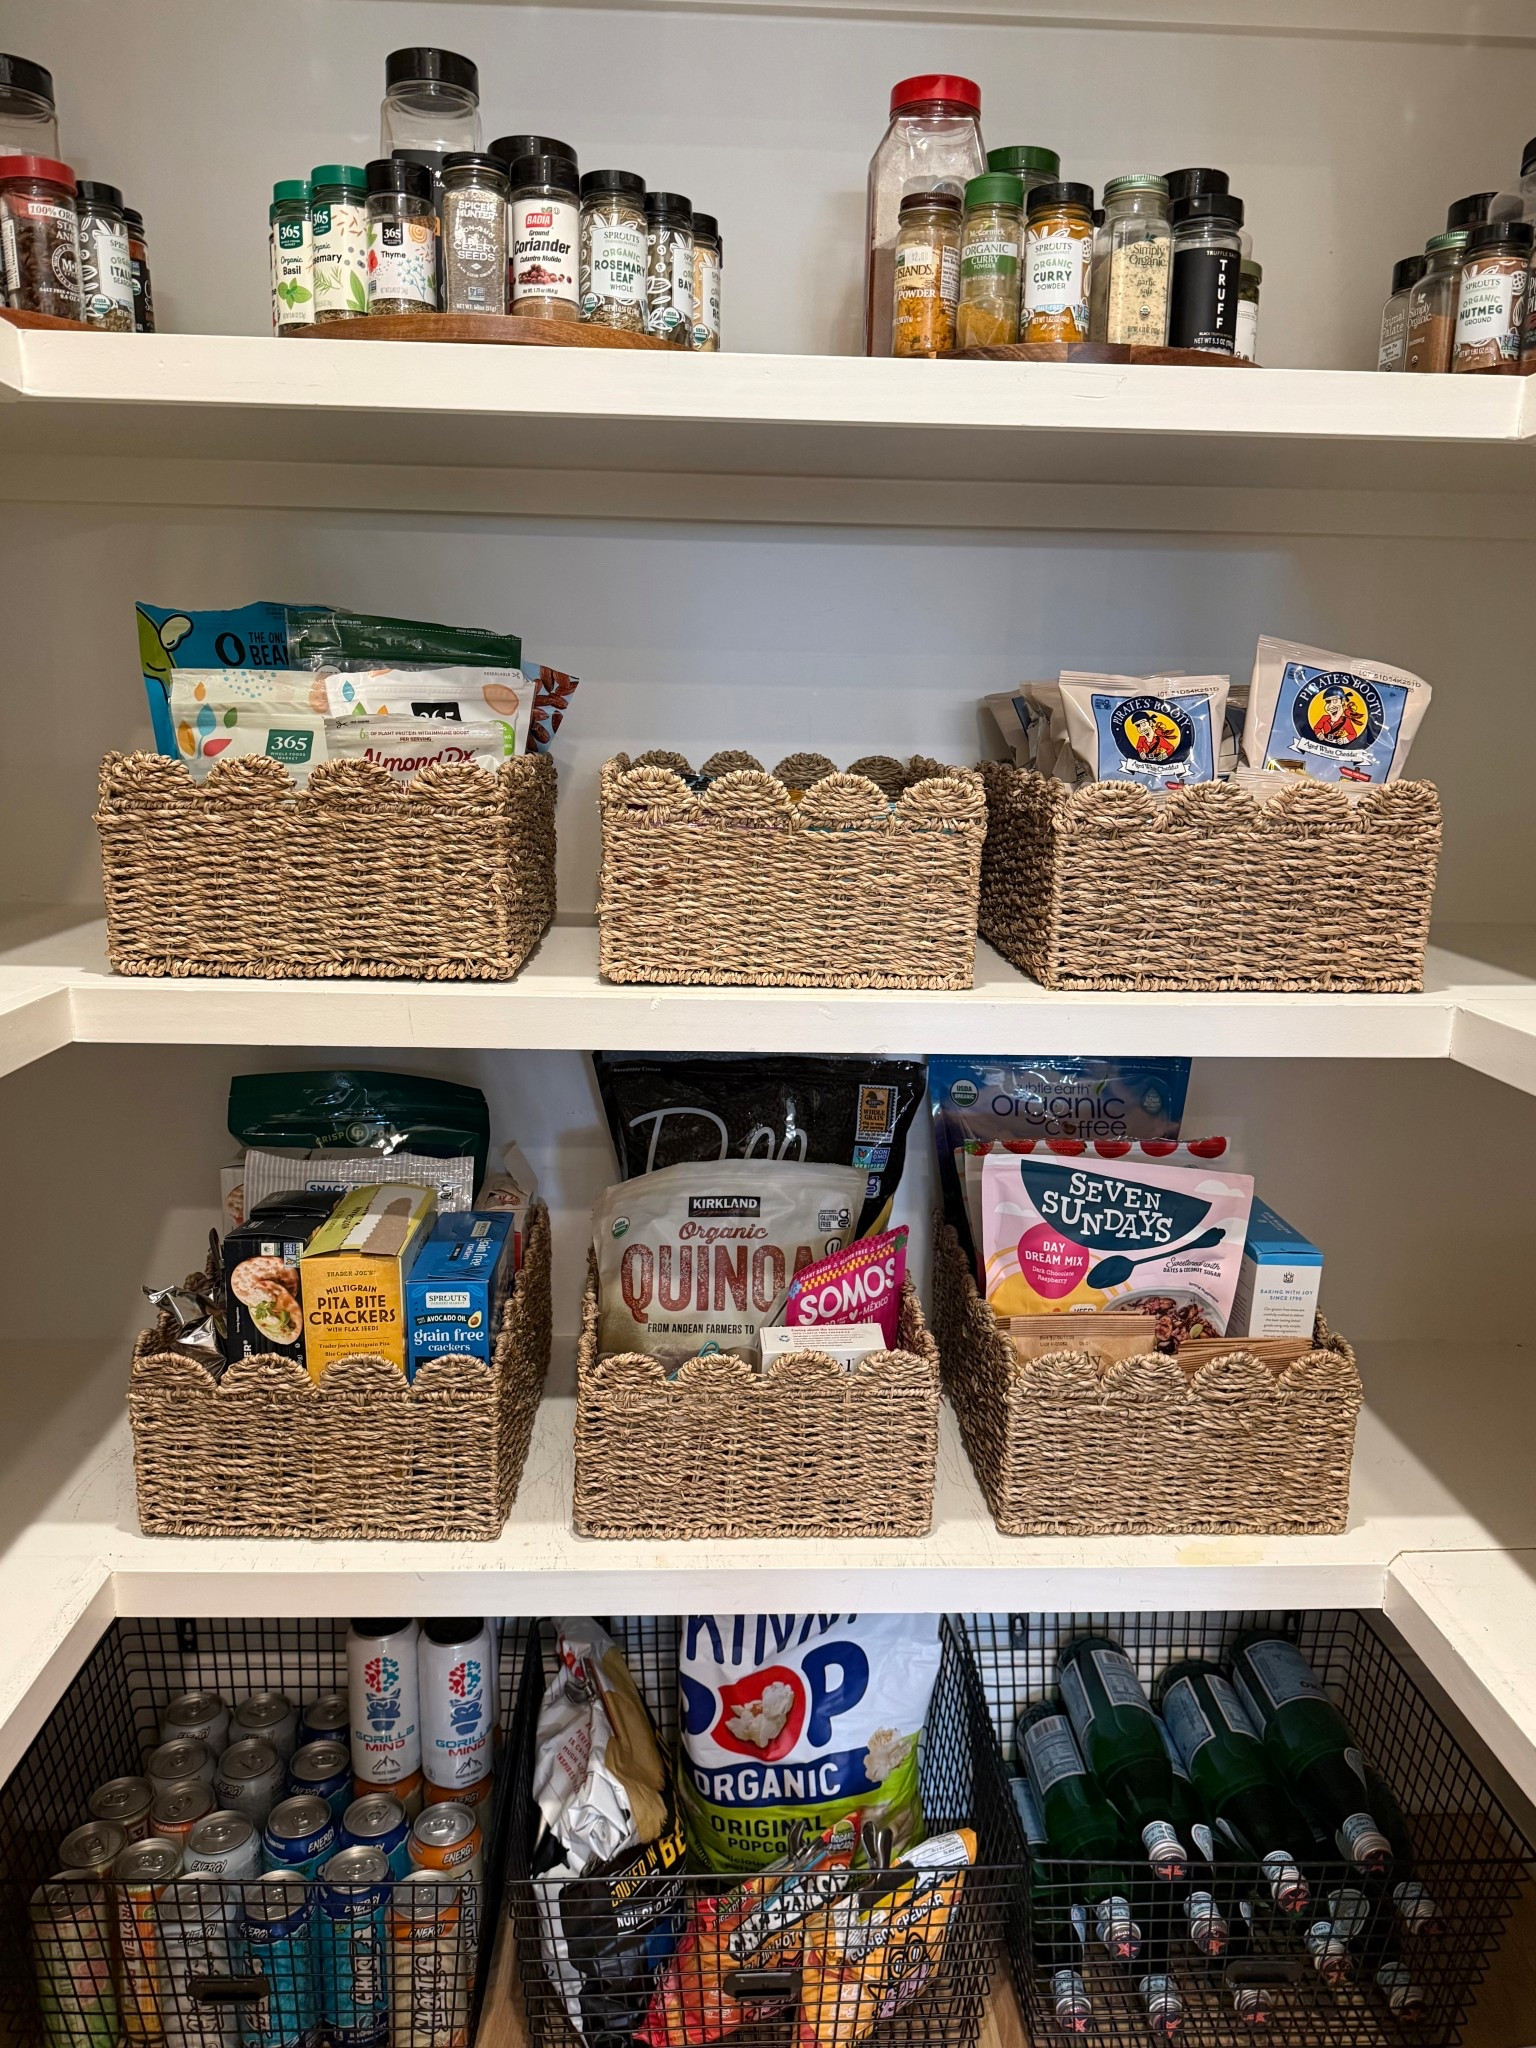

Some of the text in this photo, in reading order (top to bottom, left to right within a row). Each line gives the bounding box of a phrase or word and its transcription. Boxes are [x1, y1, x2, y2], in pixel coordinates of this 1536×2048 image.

[29, 204, 57, 217] 100%
[313, 210, 329, 226] 365
[526, 215, 551, 226] BADIA
[280, 225, 300, 239] 365
[383, 227, 401, 240] 365
[604, 231, 640, 244] SPROUTS
[970, 229, 1006, 238] McCormick
[514, 237, 571, 255] Coriander
[964, 244, 1009, 257] ORGANIC
[1035, 243, 1072, 253] SPROUTS
[1133, 244, 1165, 259] Simply
[280, 255, 303, 265] Organic
[381, 250, 406, 260] Thyme
[457, 250, 496, 262] SEEDS
[520, 255, 562, 264] Culantro Molido
[603, 248, 641, 262] ORGANIC
[971, 255, 1000, 265] CURRY
[1129, 254, 1166, 268] Organic
[283, 265, 301, 276] Basil
[595, 260, 645, 277] ROSEMARY
[1033, 258, 1073, 271] ORGANIC
[611, 271, 634, 285] LEAF
[1033, 270, 1072, 283] CURRY
[1137, 277, 1156, 287] garlic
[610, 284, 634, 293] WHOLE
[1037, 283, 1066, 291] POWDER
[1140, 286, 1153, 296] salt
[1465, 279, 1501, 291] SPROUTS
[898, 288, 936, 300] POWDER
[1216, 259, 1228, 329] TRUFF
[1462, 294, 1501, 308] ORGANIC
[1460, 305, 1503, 320] NUTMEG
[1464, 316, 1492, 326] GROUND
[248, 632, 287, 644] THE ONL
[1301, 674, 1383, 718] PIRATE'S BOOTY
[1112, 698, 1191, 727] PIRATE'S BOOTY
[271, 735, 308, 751] 365
[1304, 741, 1358, 758] Aged White Cheddar
[363, 748, 443, 772] Almond
[954, 1092, 975, 1100] ORGANIC
[1054, 1084, 1090, 1096] earth
[991, 1093, 1125, 1125] organic
[316, 1131, 344, 1145] CRISP
[1069, 1172, 1161, 1211] SEVEN
[692, 1198, 758, 1209] KIRKLAND
[1041, 1190, 1173, 1243] SUNDAYS
[678, 1221, 768, 1244] Organic
[1043, 1241, 1066, 1253] DAY
[799, 1270, 815, 1282] PLANT
[815, 1264, 832, 1276] BASED
[855, 1248, 868, 1257] FREE
[1025, 1250, 1084, 1267] DREAM MIX
[1166, 1256, 1221, 1270] Sweetened with
[1032, 1266, 1074, 1277] Dark Chocolate
[1203, 1269, 1221, 1277] SUGAR
[1037, 1275, 1067, 1285] Raspberry
[325, 1284, 377, 1295] MULTIGRAIN
[798, 1257, 895, 1325] SOMOS
[317, 1295, 386, 1310] PITA BITE
[428, 1294, 468, 1302] SPROUTS
[309, 1308, 396, 1326] CRACKERS
[647, 1323, 755, 1334] FROM ANDEAN FARMERS TO
[414, 1327, 484, 1345] grain free
[428, 1343, 471, 1351] crackers
[356, 1724, 415, 1744] GORILLA
[435, 1723, 492, 1749] GORILLA
[365, 1739, 405, 1752] MIND
[448, 1738, 486, 1757] MIND
[694, 1763, 841, 1801] ORGANIC
[711, 1815, 827, 1838] ORIGINAL
[308, 1826, 335, 1854] ENERGY
[443, 1844, 474, 1865] ENERGY
[191, 1859, 227, 1874] ENERGY
